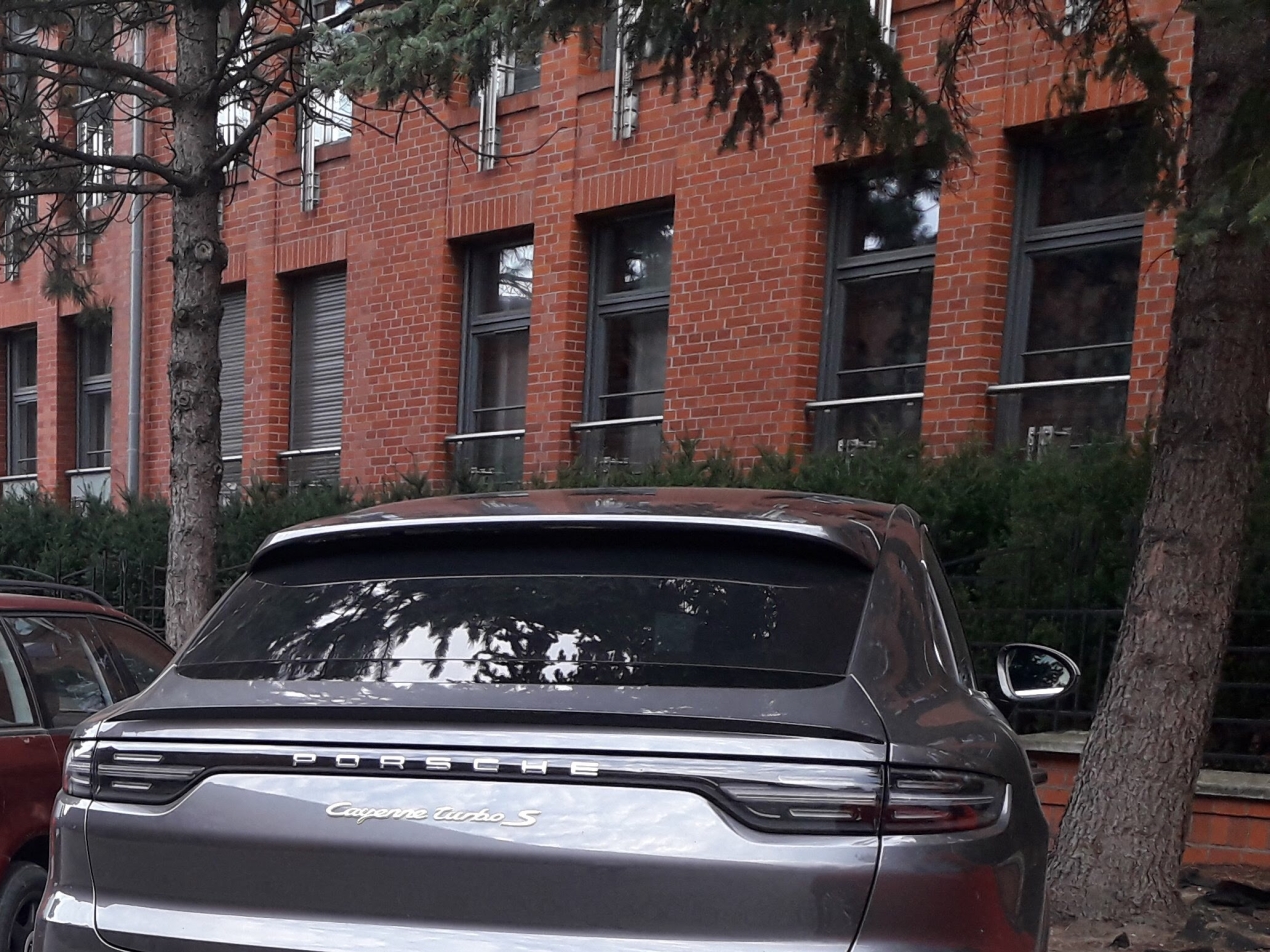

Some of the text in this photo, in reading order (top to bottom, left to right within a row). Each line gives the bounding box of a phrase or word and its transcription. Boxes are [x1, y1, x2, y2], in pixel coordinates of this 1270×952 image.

[292, 752, 600, 777] PORSCHE
[325, 801, 429, 825] Cayenne
[500, 809, 542, 827] S
